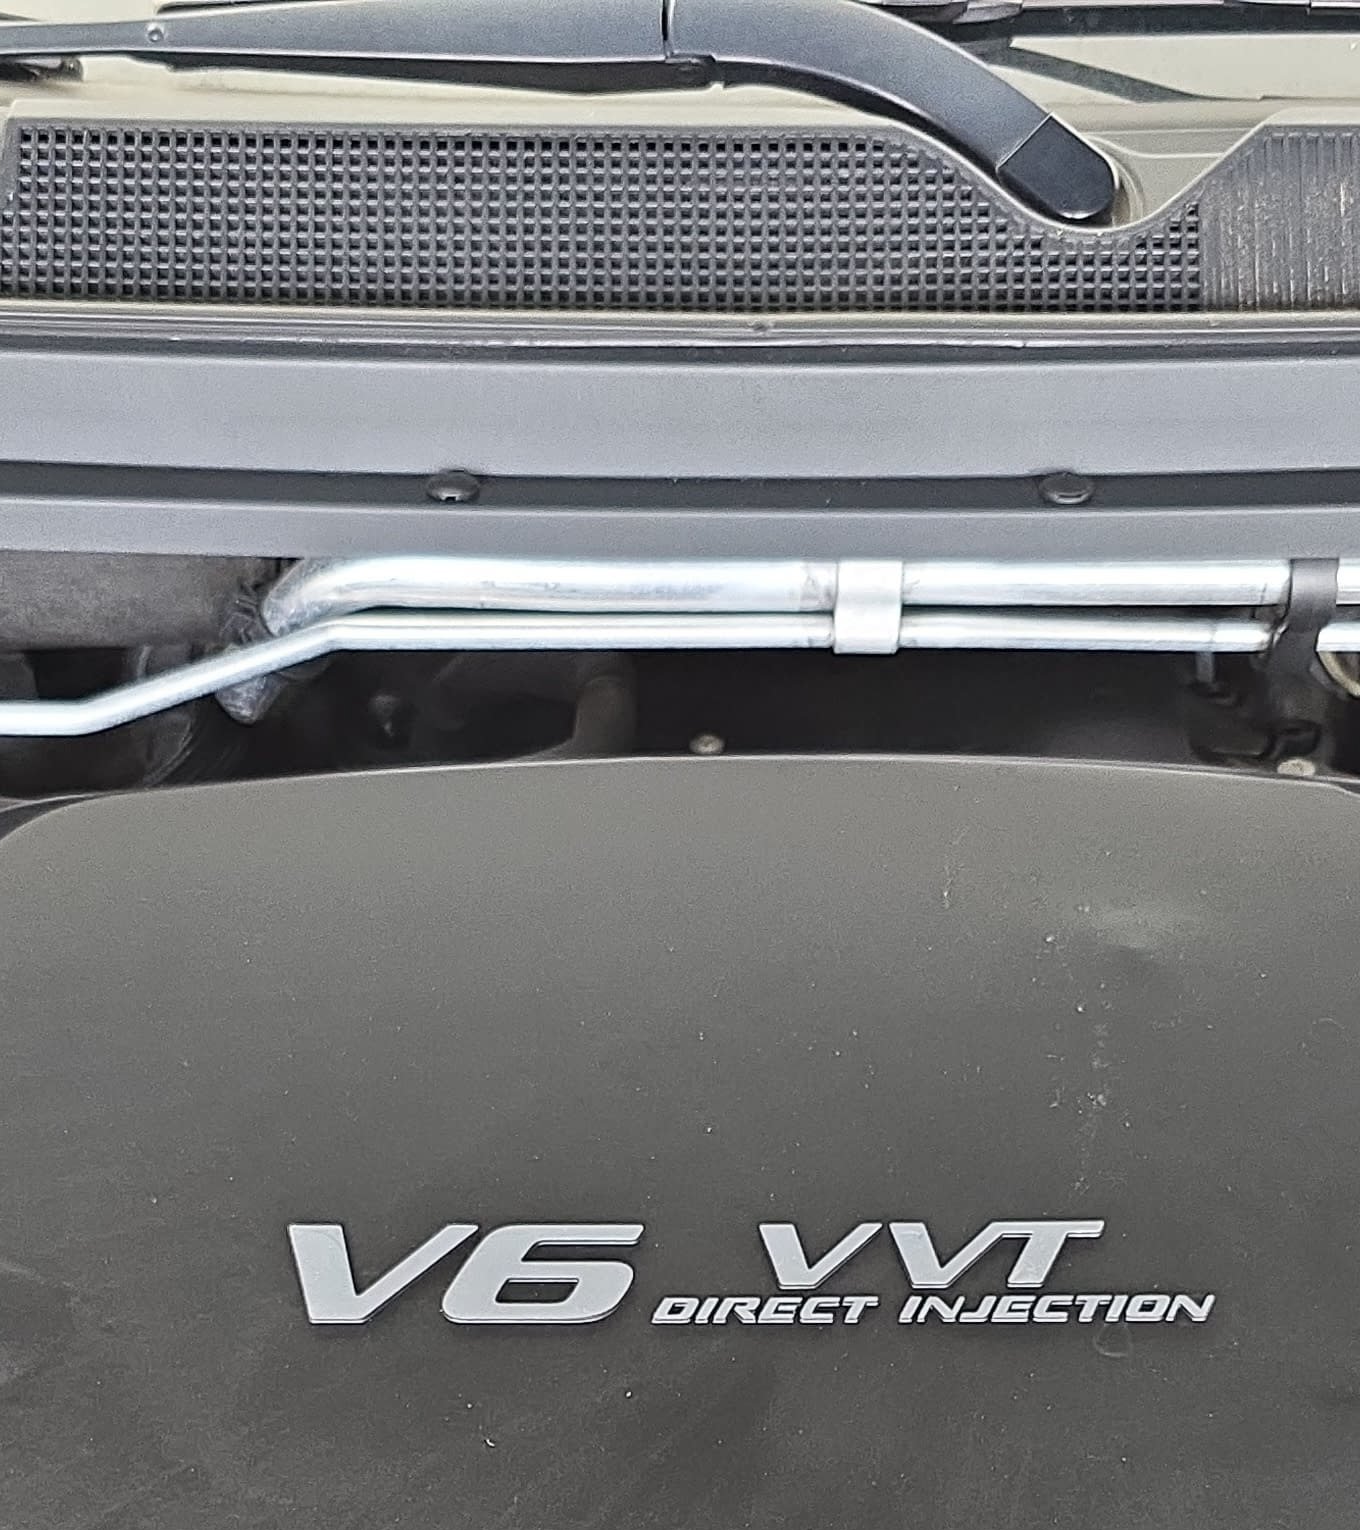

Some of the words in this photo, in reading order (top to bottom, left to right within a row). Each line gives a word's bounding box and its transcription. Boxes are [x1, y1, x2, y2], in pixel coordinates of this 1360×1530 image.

[289, 1224, 644, 1324] V6
[759, 1220, 1104, 1289] VVT
[651, 1295, 880, 1324] DIRECT
[897, 1294, 1215, 1324] INJECTION
